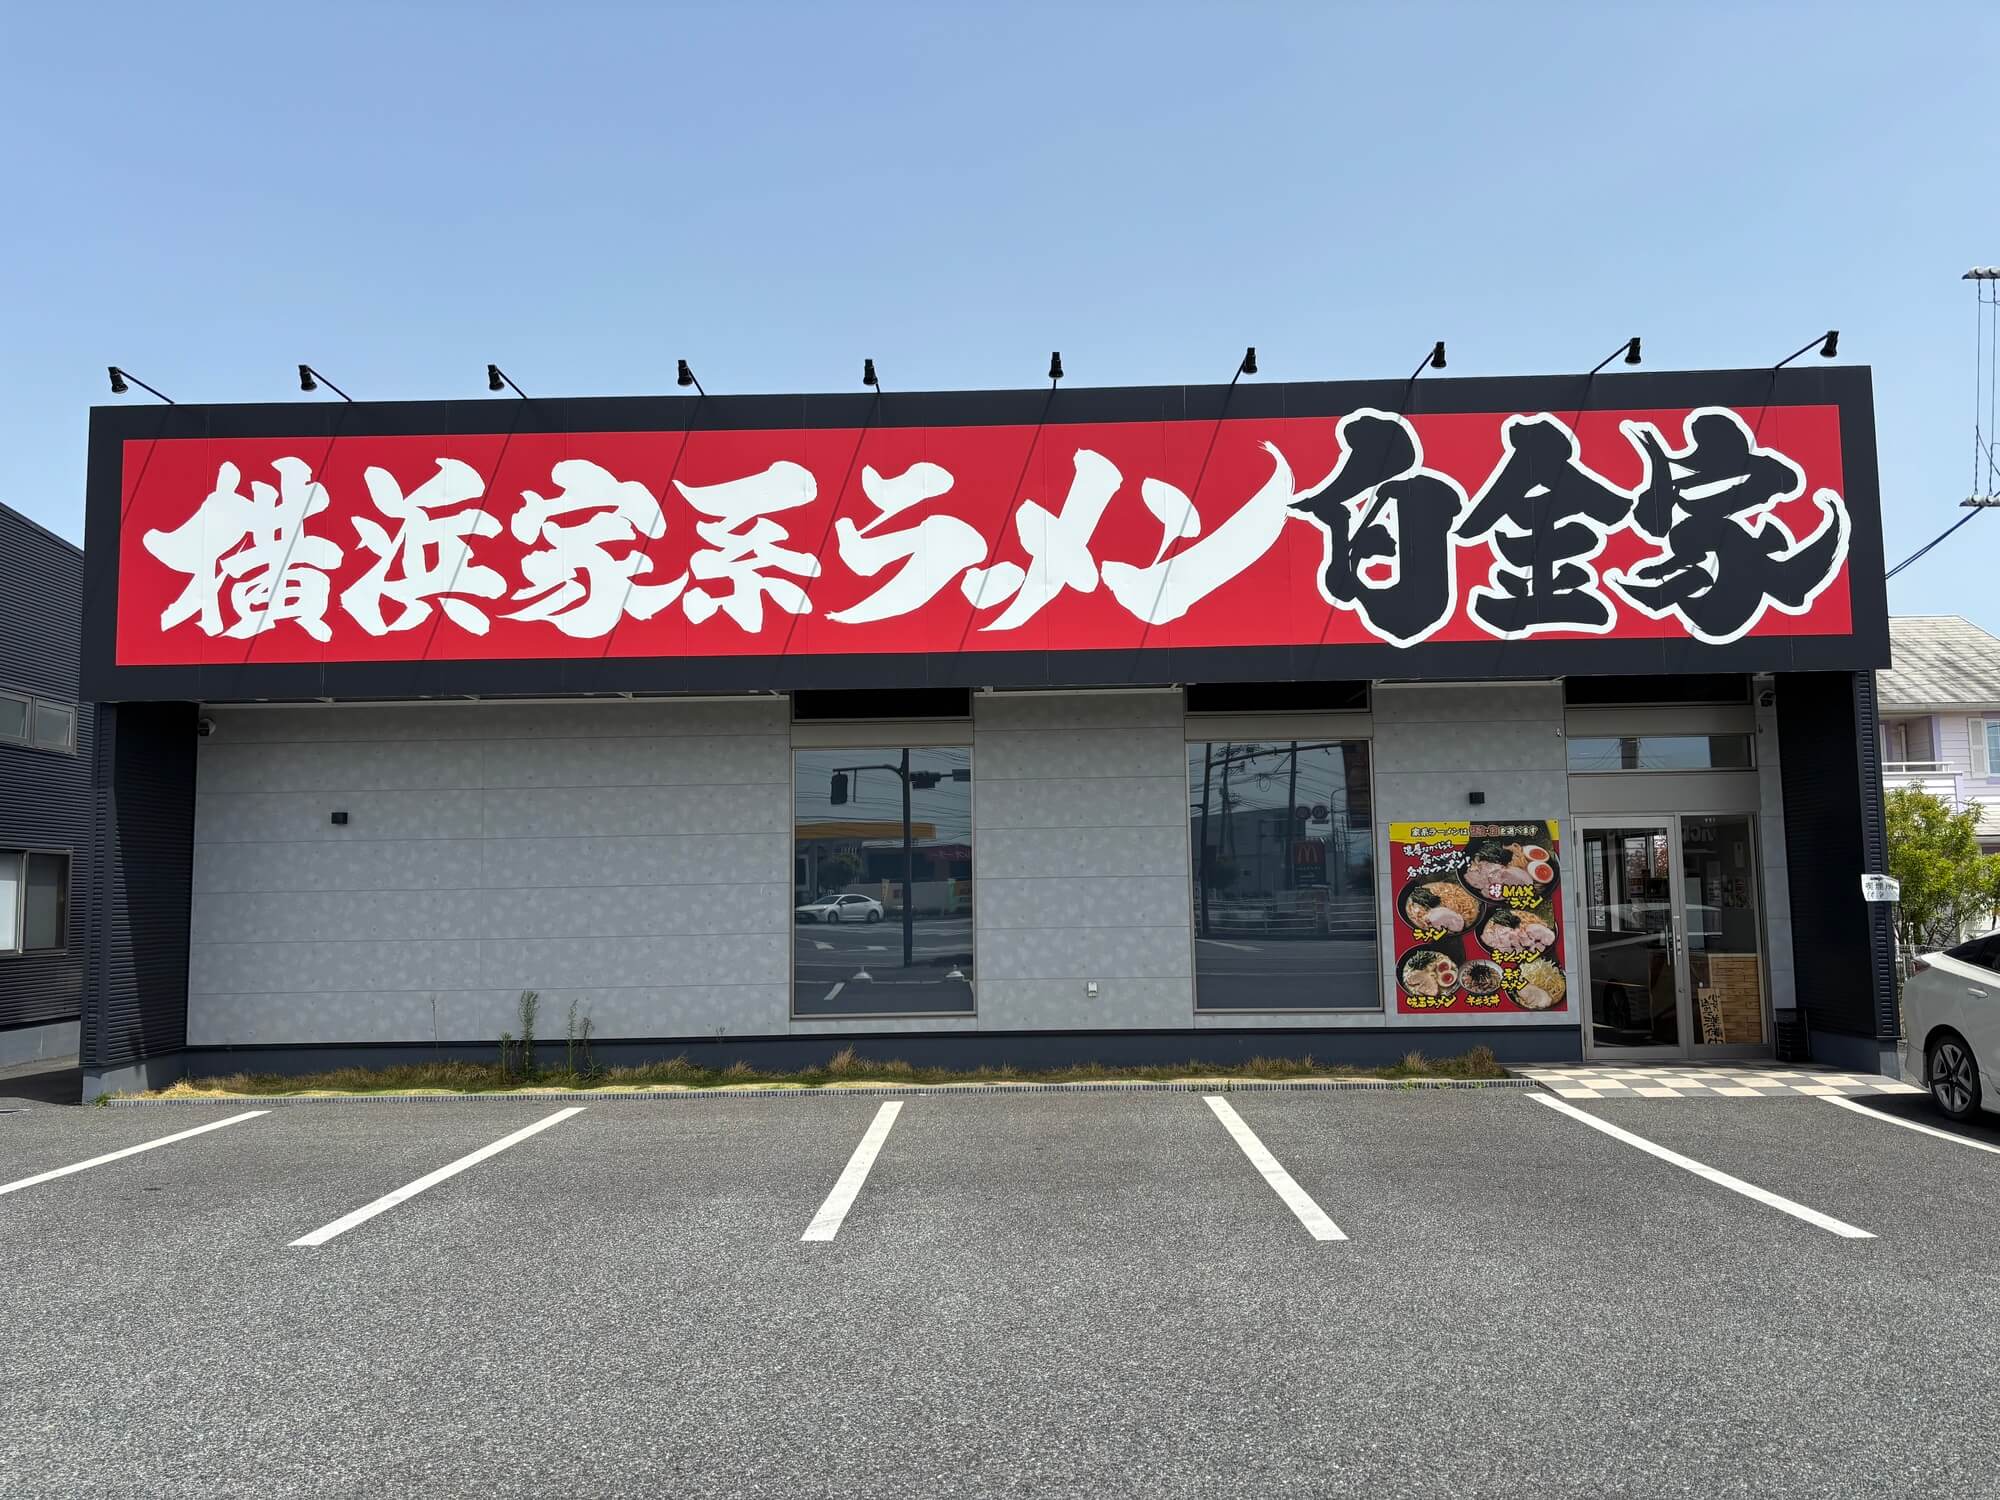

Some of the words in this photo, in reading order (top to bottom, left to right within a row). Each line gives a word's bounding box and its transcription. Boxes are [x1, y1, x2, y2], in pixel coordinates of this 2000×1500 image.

[143, 440, 1295, 643] 横浜家系ラーメン
[1411, 824, 1538, 838] 家系ラーメンは・を選べます
